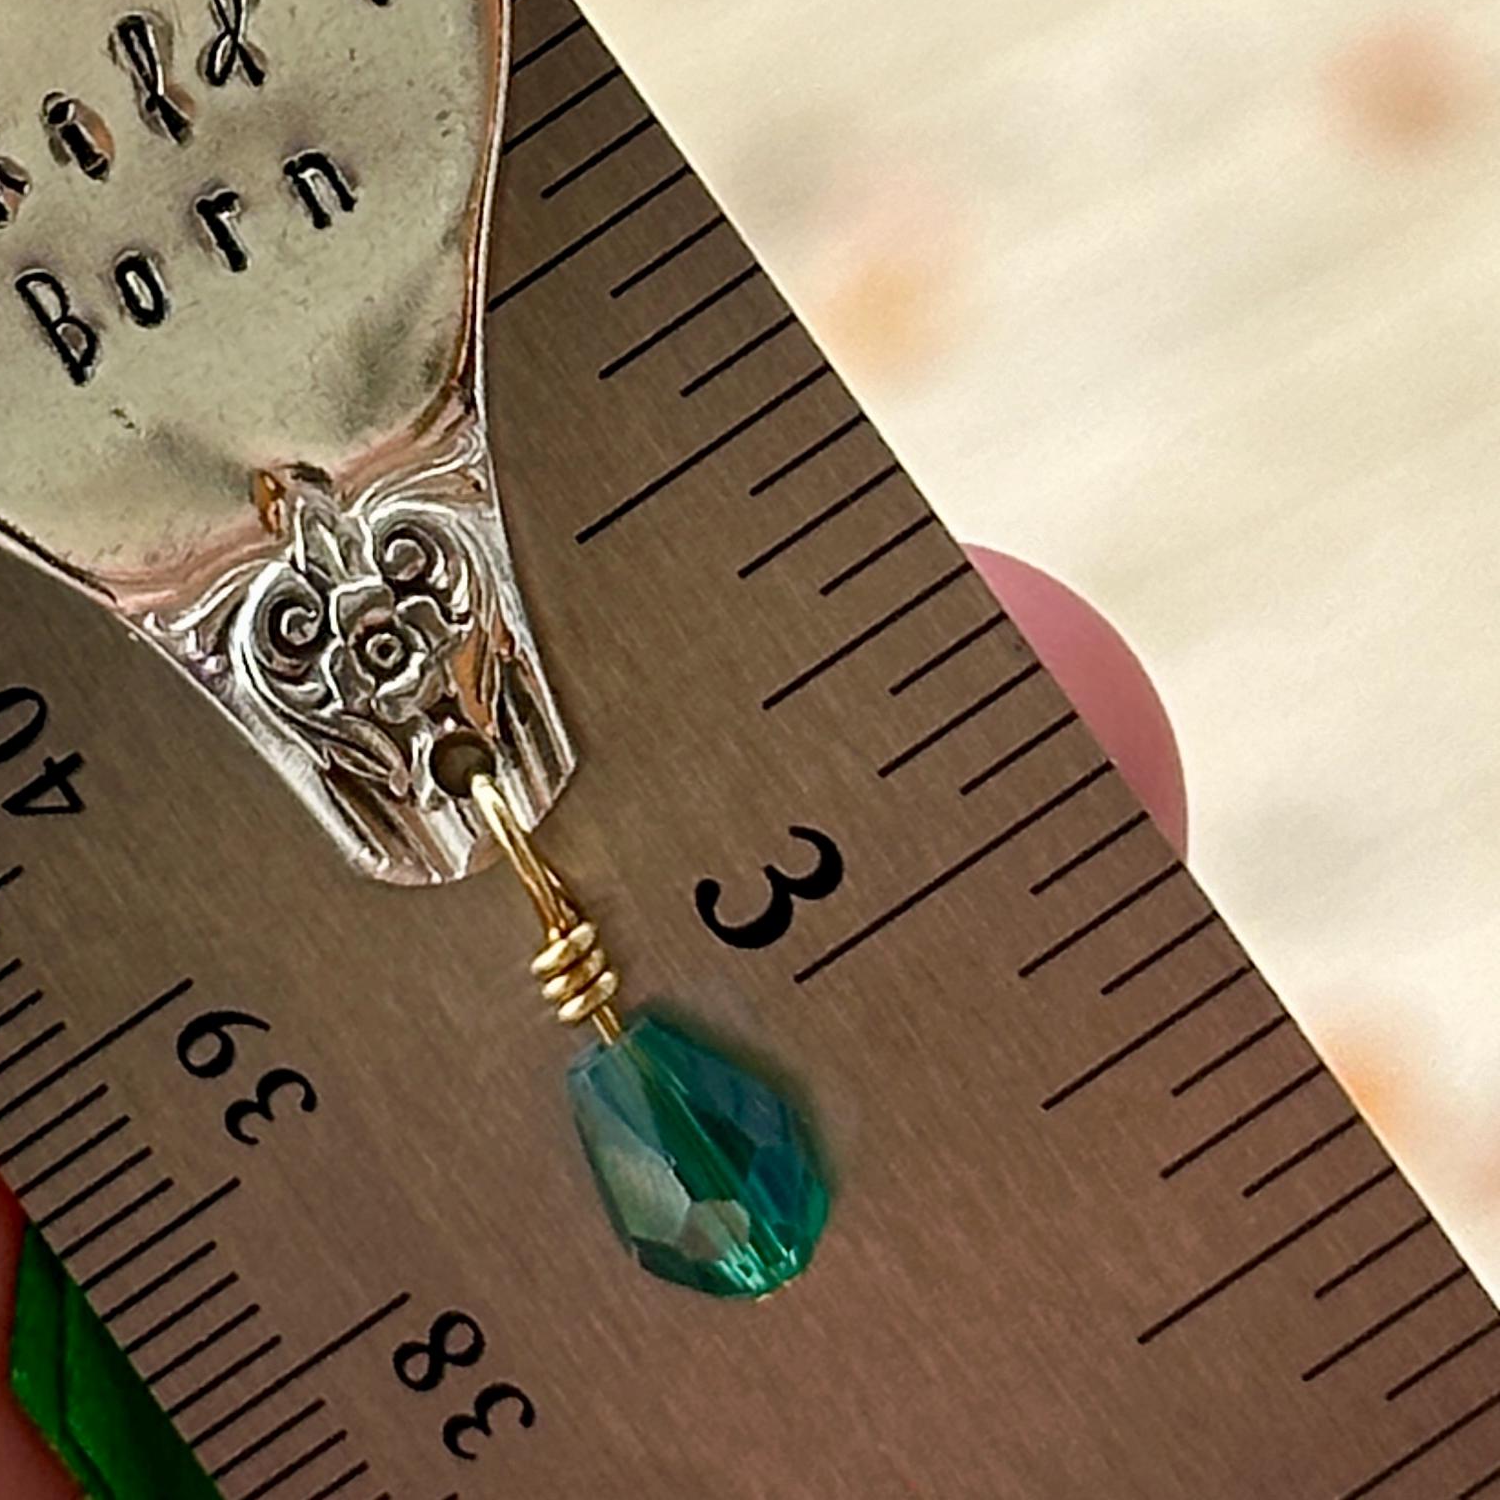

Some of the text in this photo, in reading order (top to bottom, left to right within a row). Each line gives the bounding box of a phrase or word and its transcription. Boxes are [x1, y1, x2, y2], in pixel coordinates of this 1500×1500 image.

[15, 152, 357, 386] Born
[694, 825, 845, 950] 3
[176, 1010, 318, 1147] 39
[392, 1310, 536, 1462] 38
